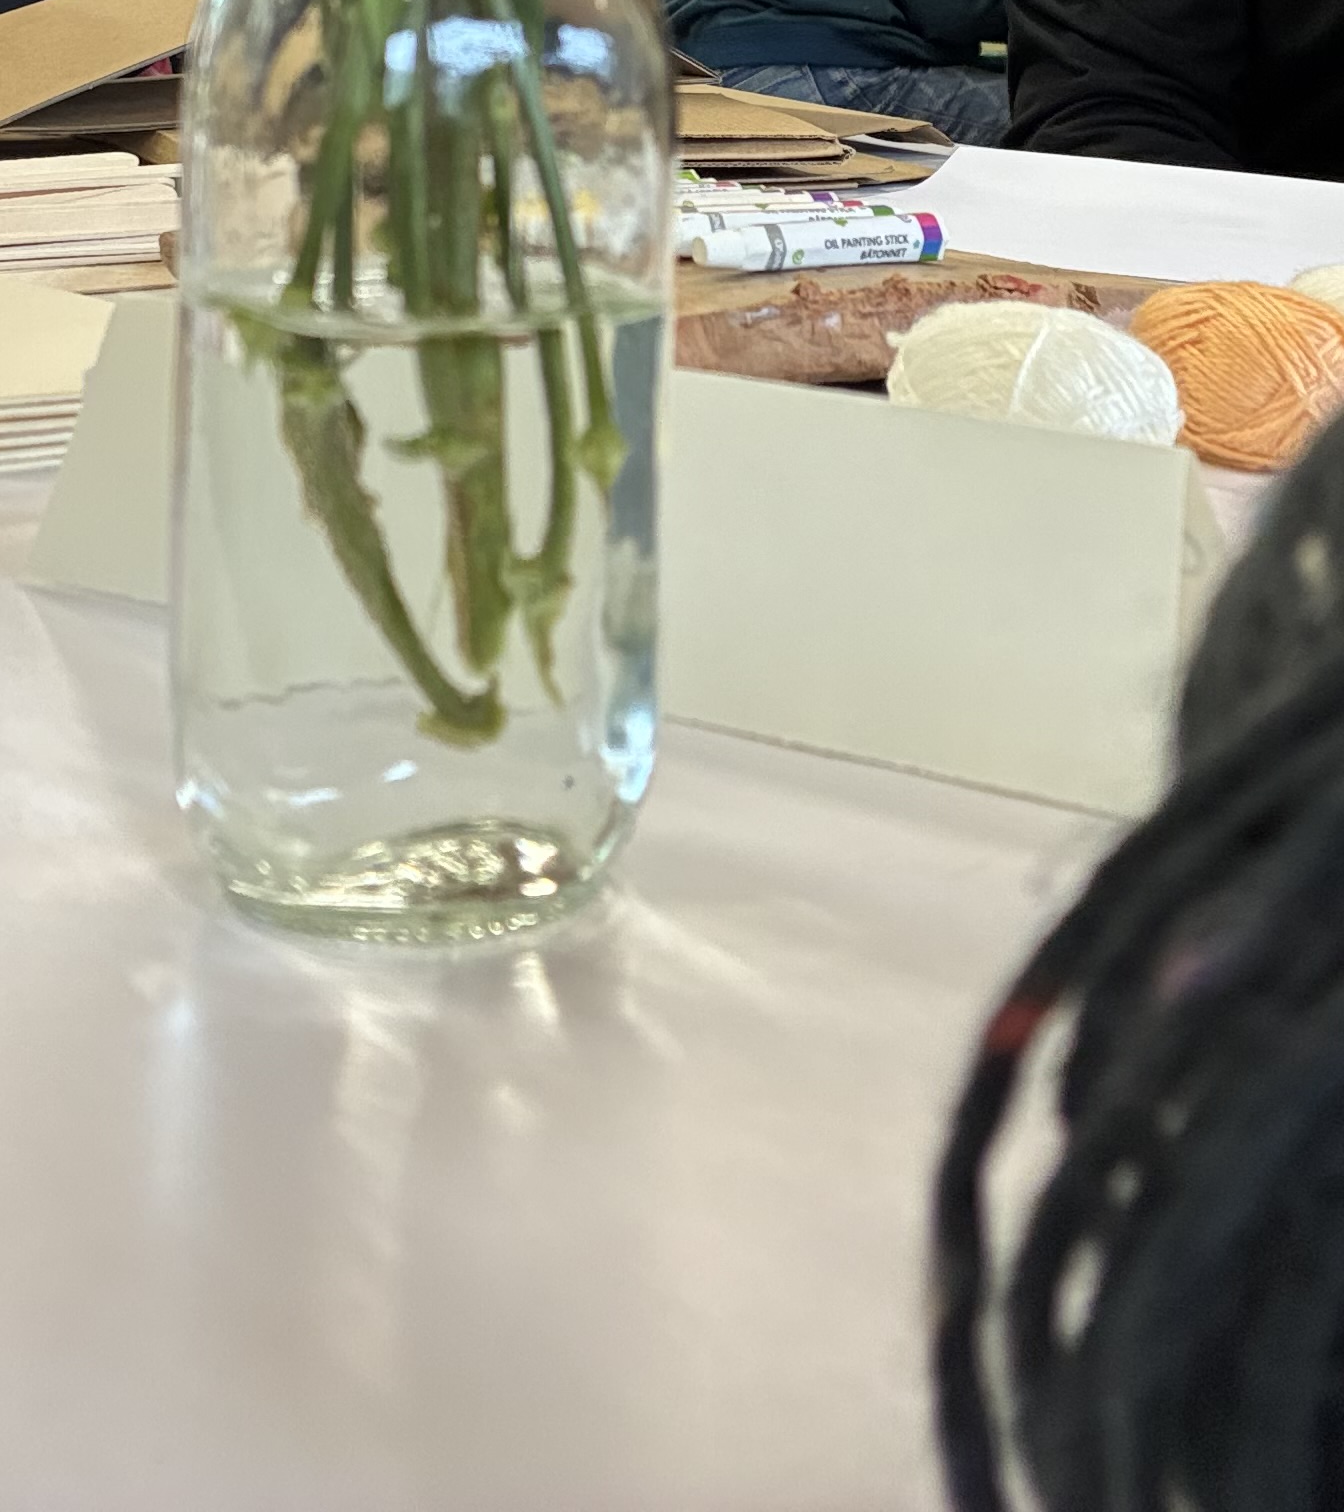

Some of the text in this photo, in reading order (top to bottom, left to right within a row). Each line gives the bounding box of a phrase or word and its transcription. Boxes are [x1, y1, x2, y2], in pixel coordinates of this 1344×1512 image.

[824, 234, 909, 250] OIL PAINTING STICK
